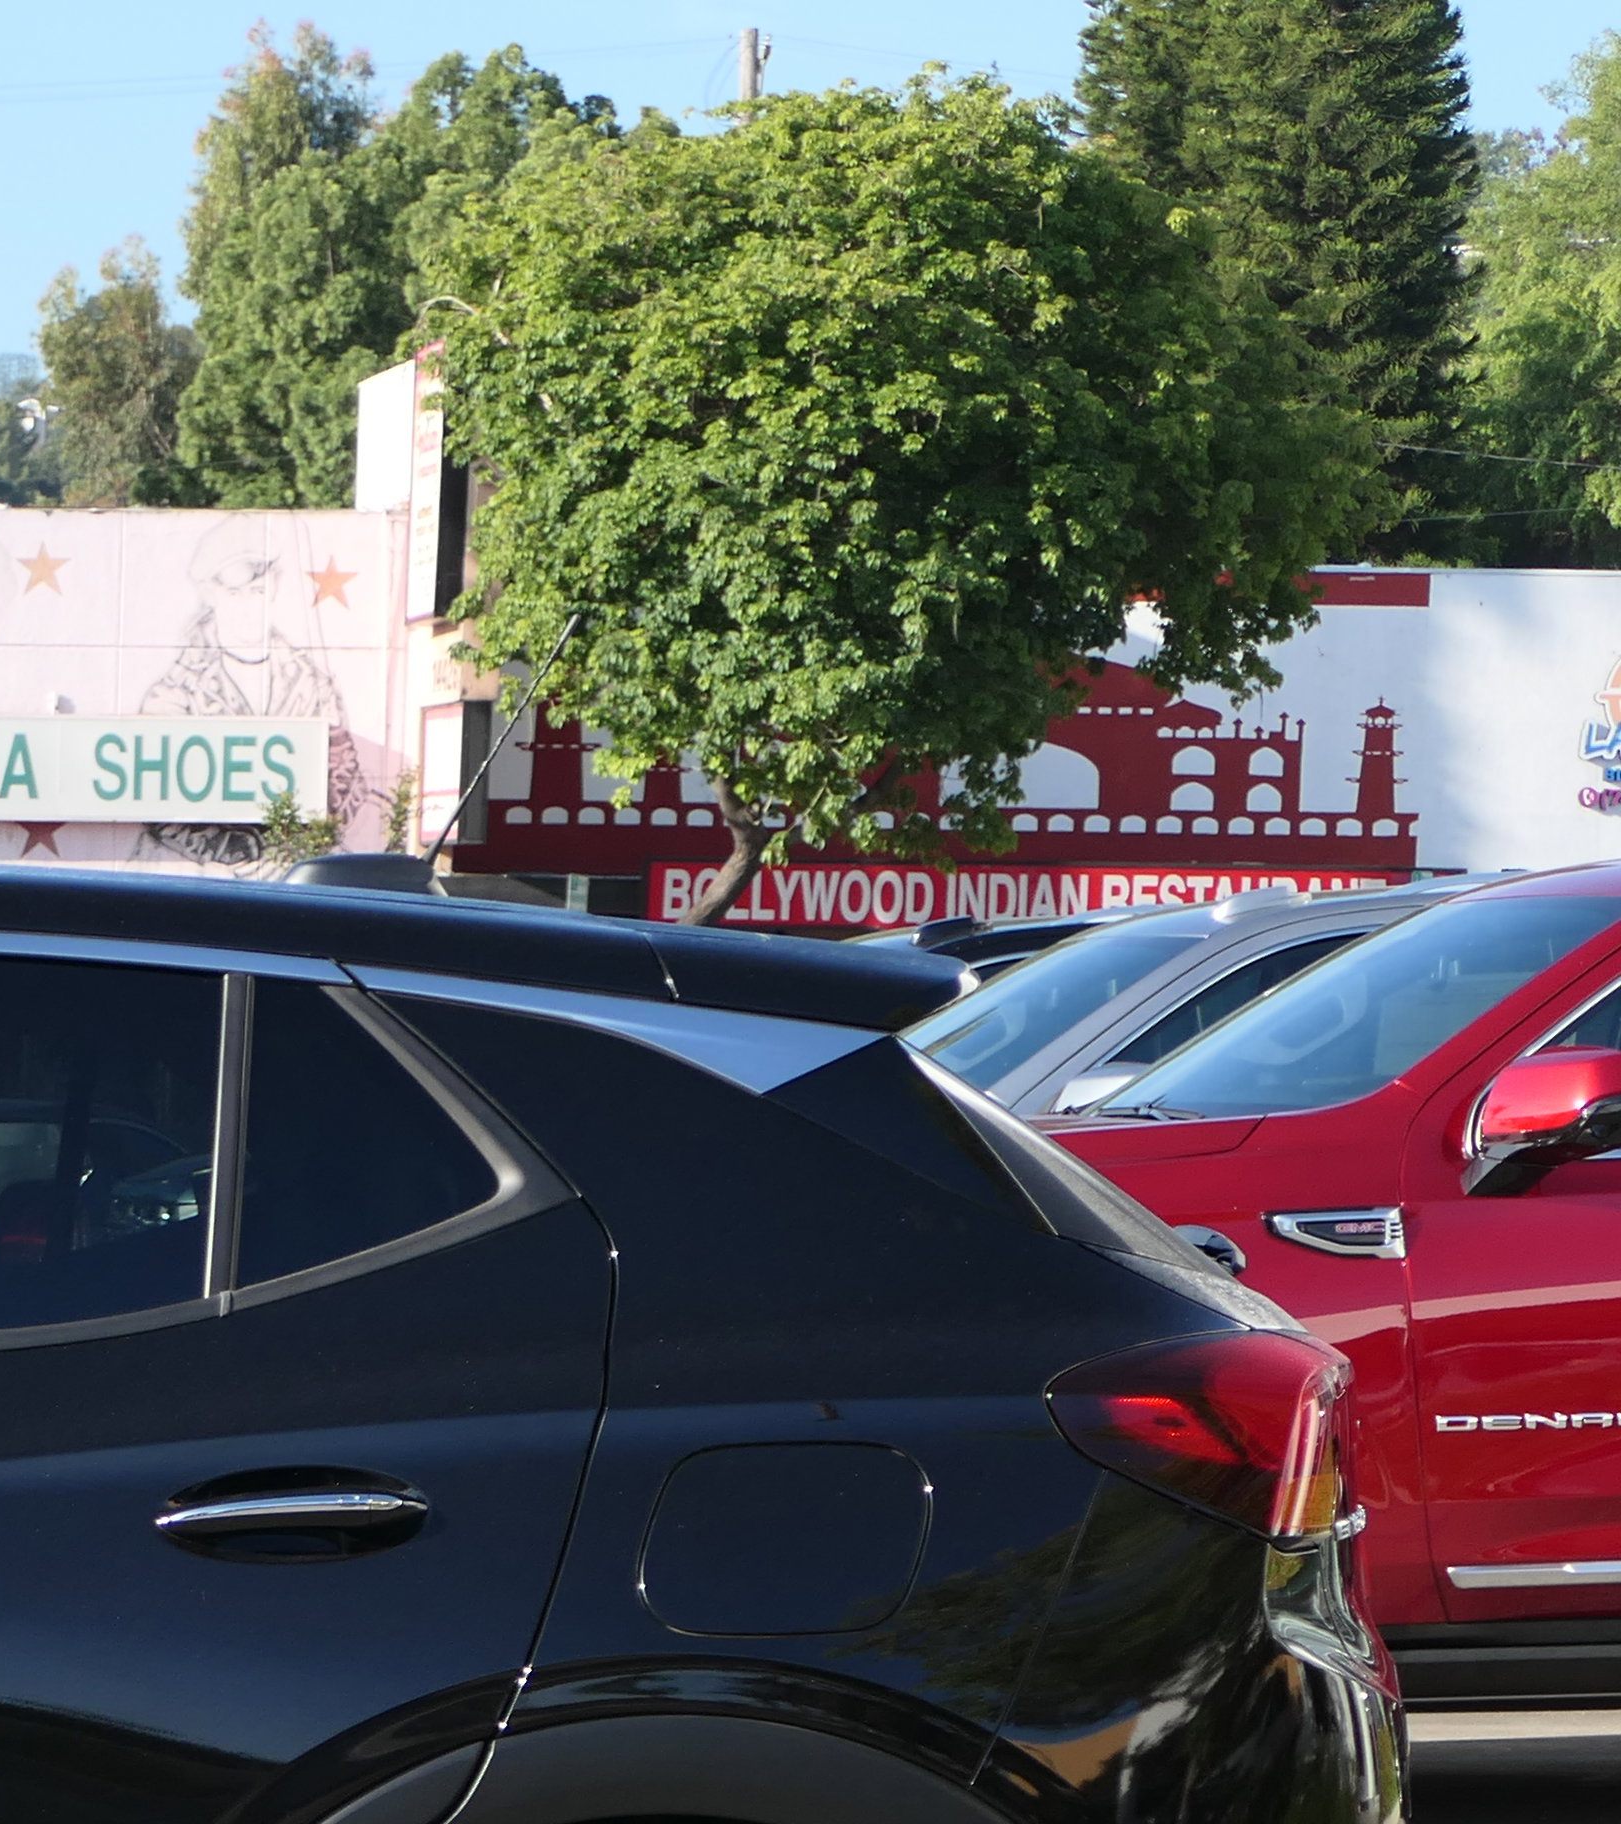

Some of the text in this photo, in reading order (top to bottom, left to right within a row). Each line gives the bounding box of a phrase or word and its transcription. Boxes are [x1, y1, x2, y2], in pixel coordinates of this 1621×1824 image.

[93, 733, 297, 803] SHOES
[945, 872, 1089, 923] INDIAN
[1336, 1221, 1386, 1234] GMC
[1435, 1412, 1621, 1432] DENA
